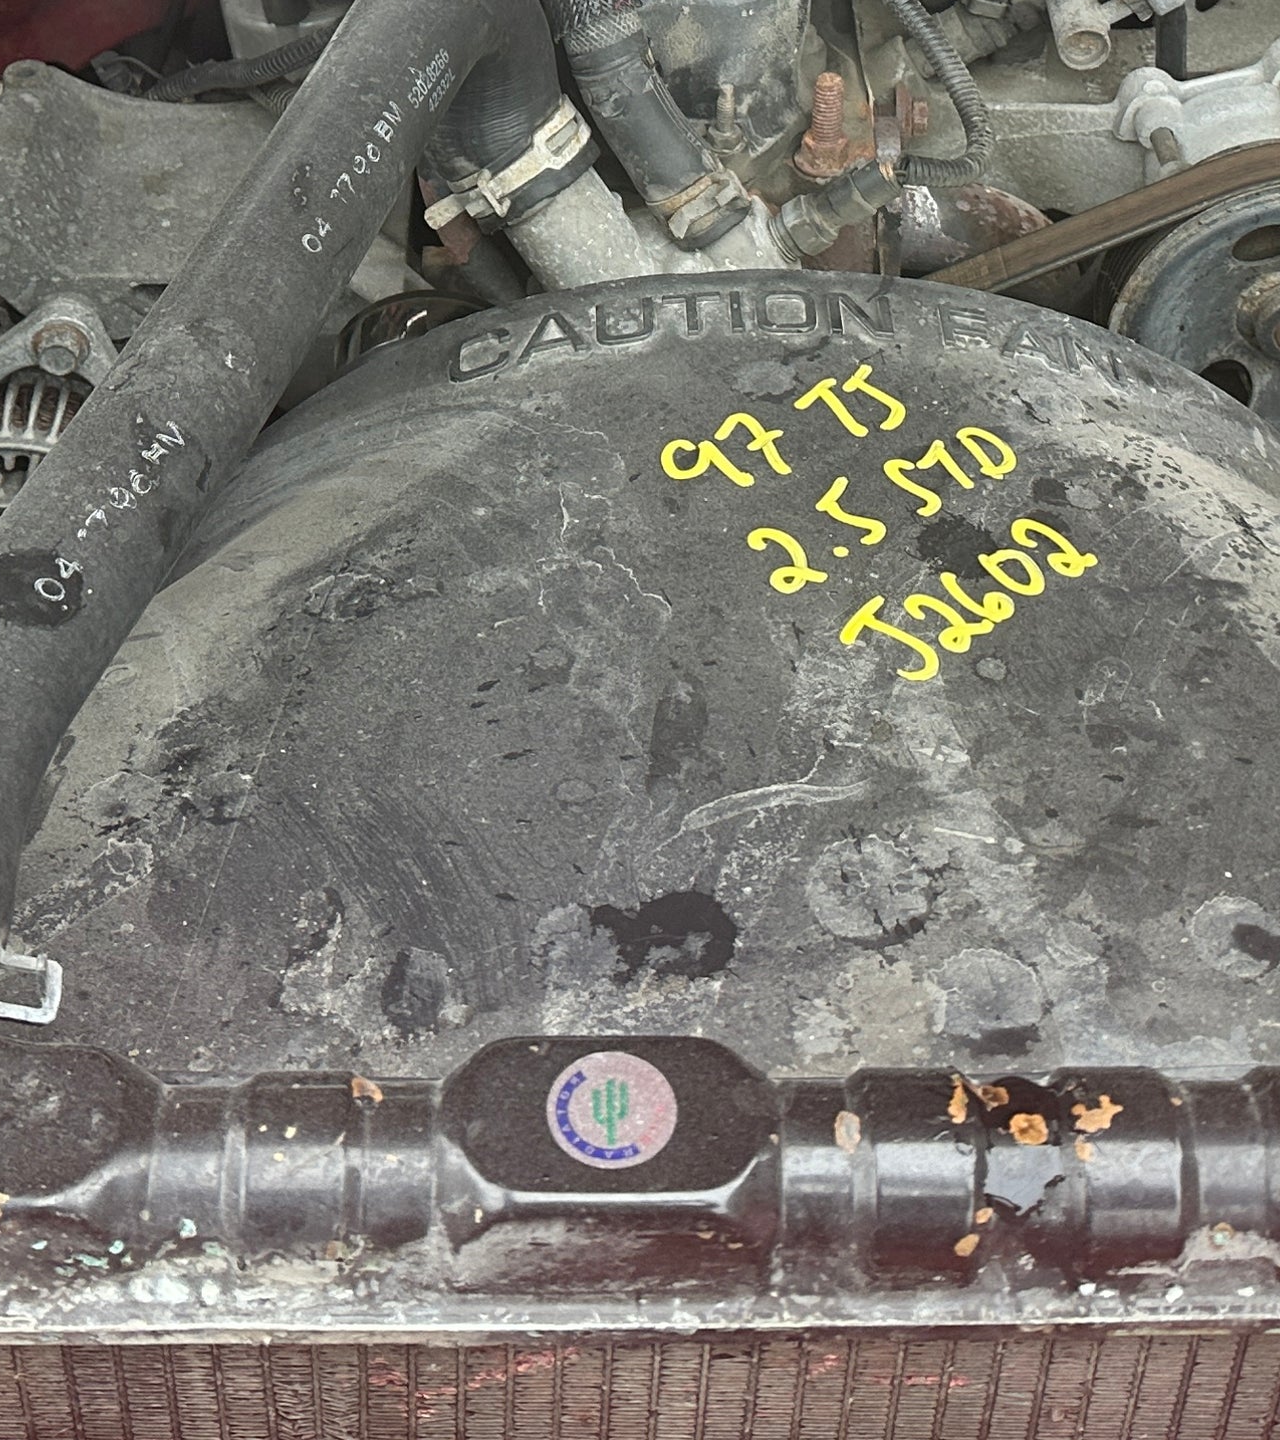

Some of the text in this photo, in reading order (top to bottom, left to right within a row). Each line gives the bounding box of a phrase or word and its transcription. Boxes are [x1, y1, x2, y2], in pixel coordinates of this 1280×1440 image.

[447, 288, 1126, 385] CAUTION FAN
[659, 364, 907, 487] 97 TJ
[746, 476, 888, 595] 2.5
[839, 517, 1099, 682] J2602
